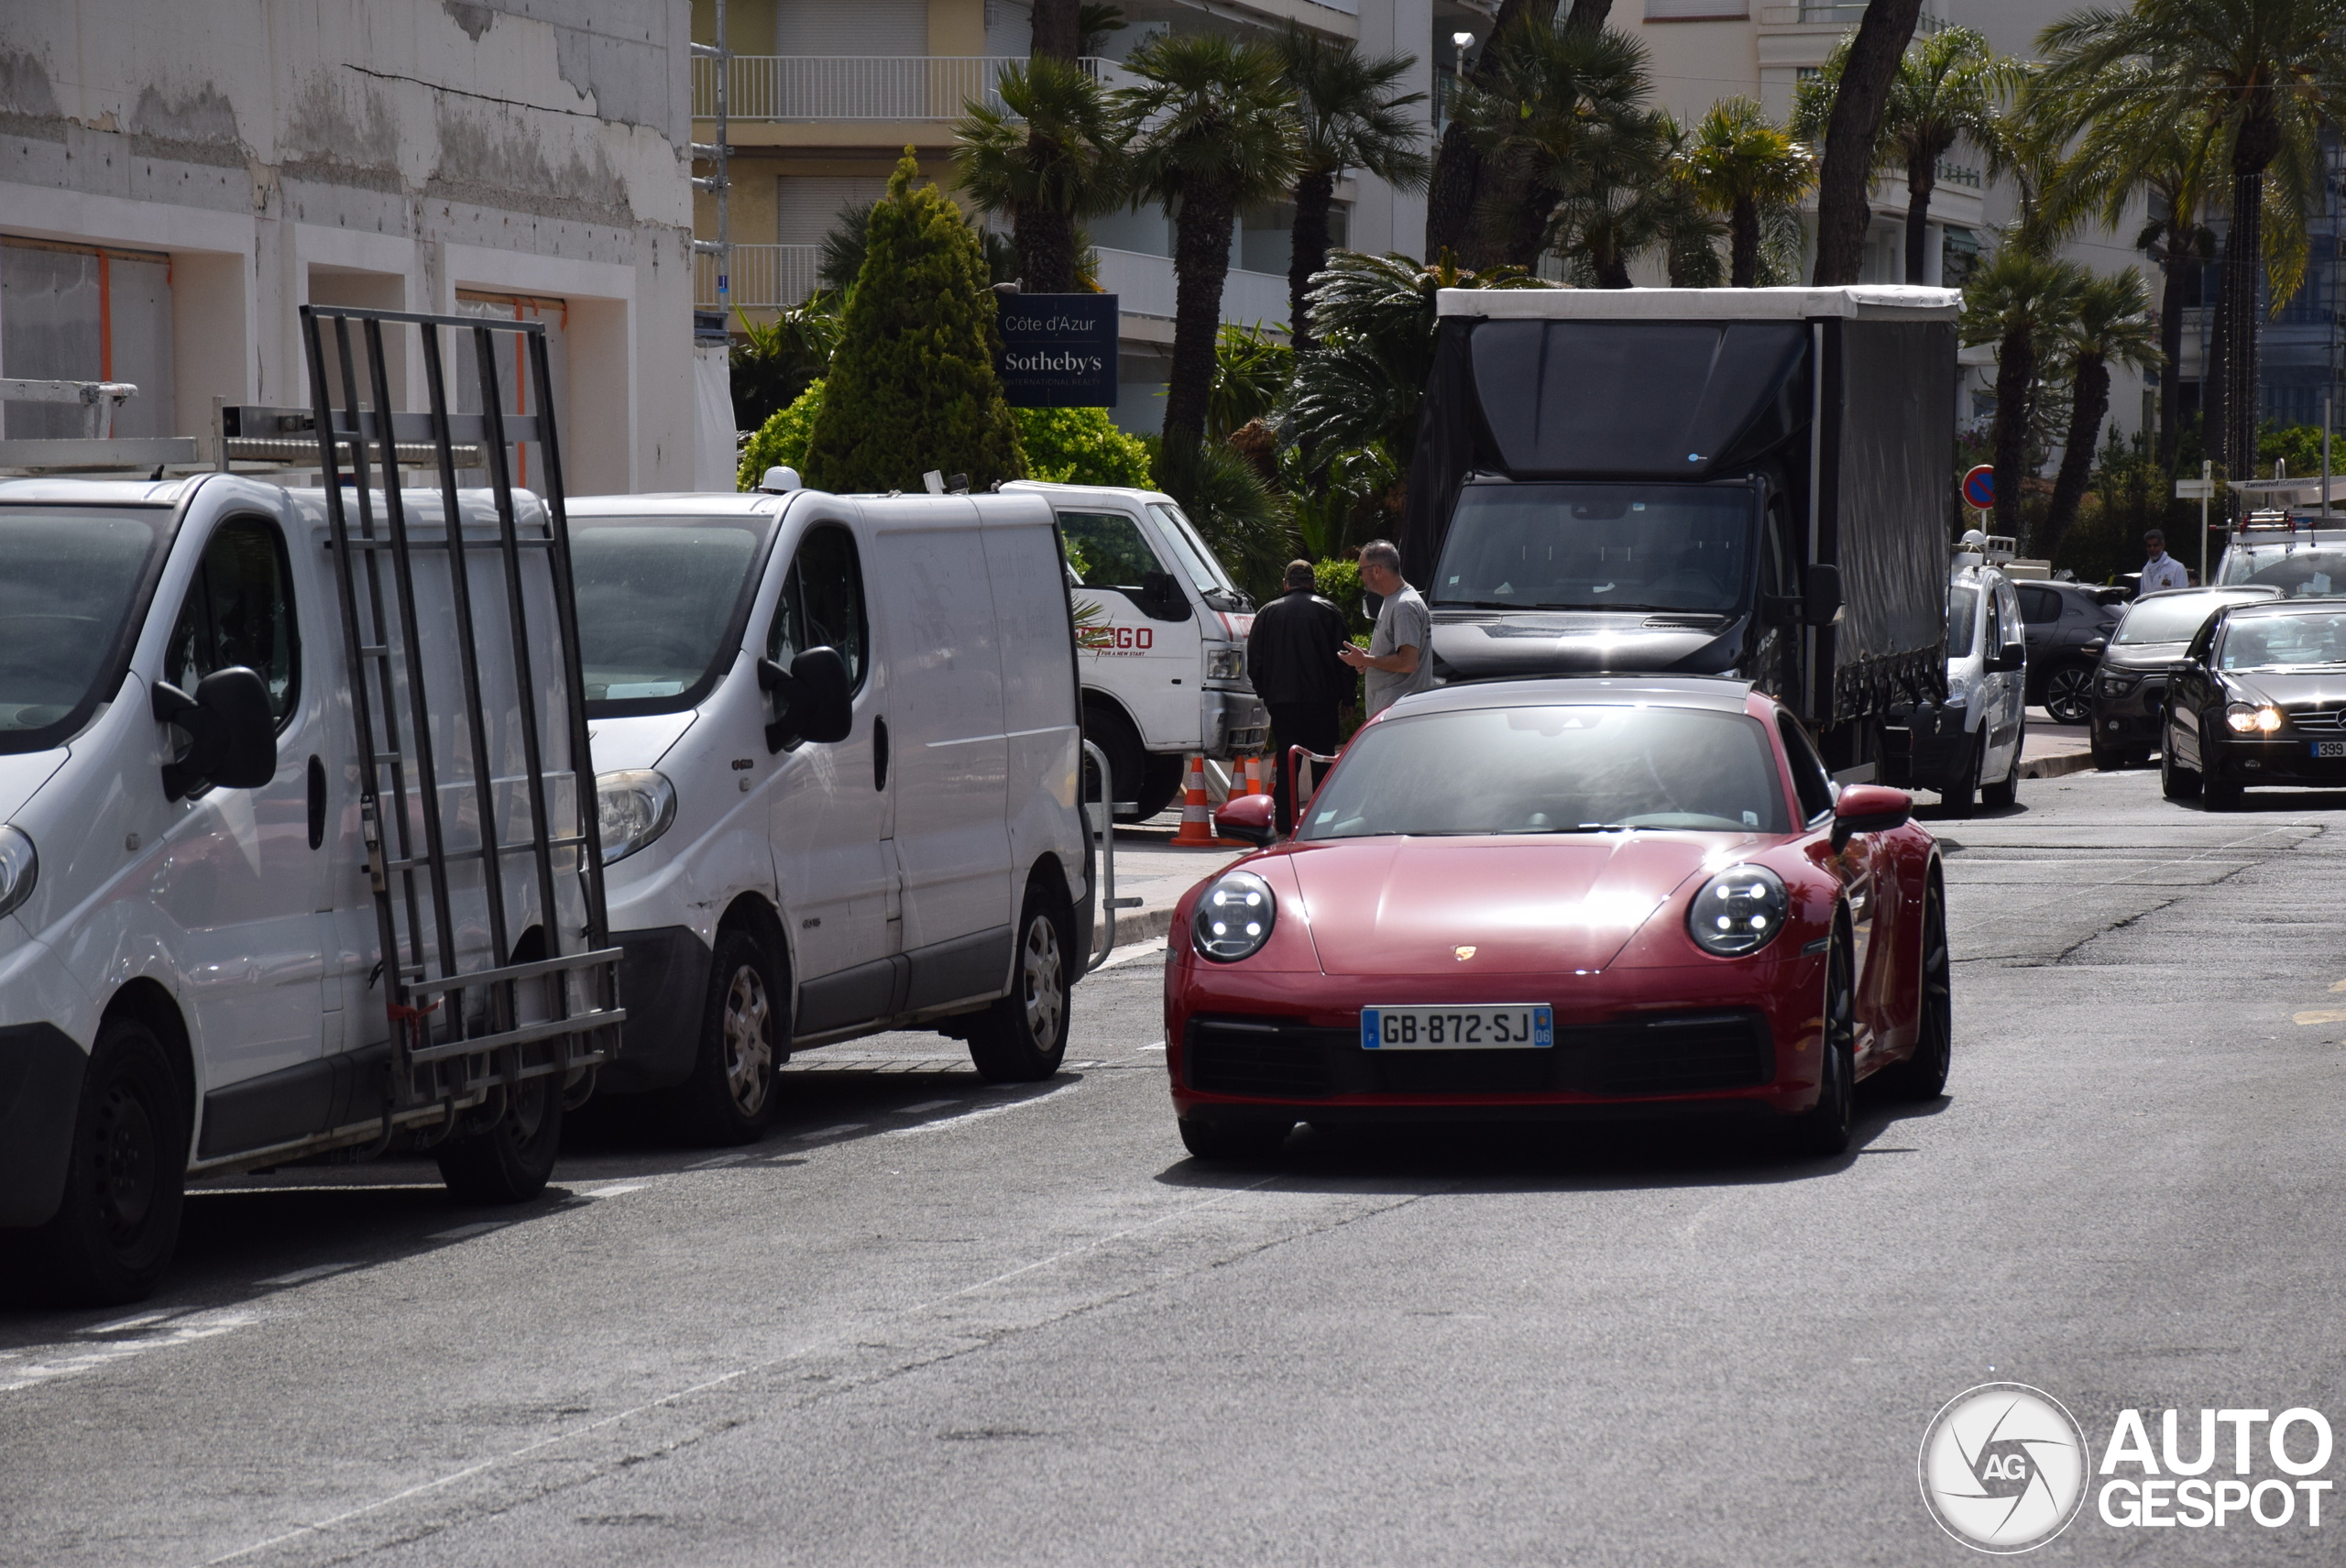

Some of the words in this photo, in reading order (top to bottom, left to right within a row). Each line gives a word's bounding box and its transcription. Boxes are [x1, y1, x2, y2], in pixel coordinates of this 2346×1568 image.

[1005, 315, 1042, 331] Côte
[1047, 315, 1096, 331] d'Azur
[1005, 351, 1102, 376] Sotheby's
[2245, 480, 2279, 488] Zamenhof
[2280, 478, 2314, 488] (Croisette)
[2320, 743, 2343, 755] 399
[1368, 1033, 1374, 1041] F
[1383, 1014, 1529, 1043] GB-872-SJ
[1535, 1029, 1551, 1043] 06
